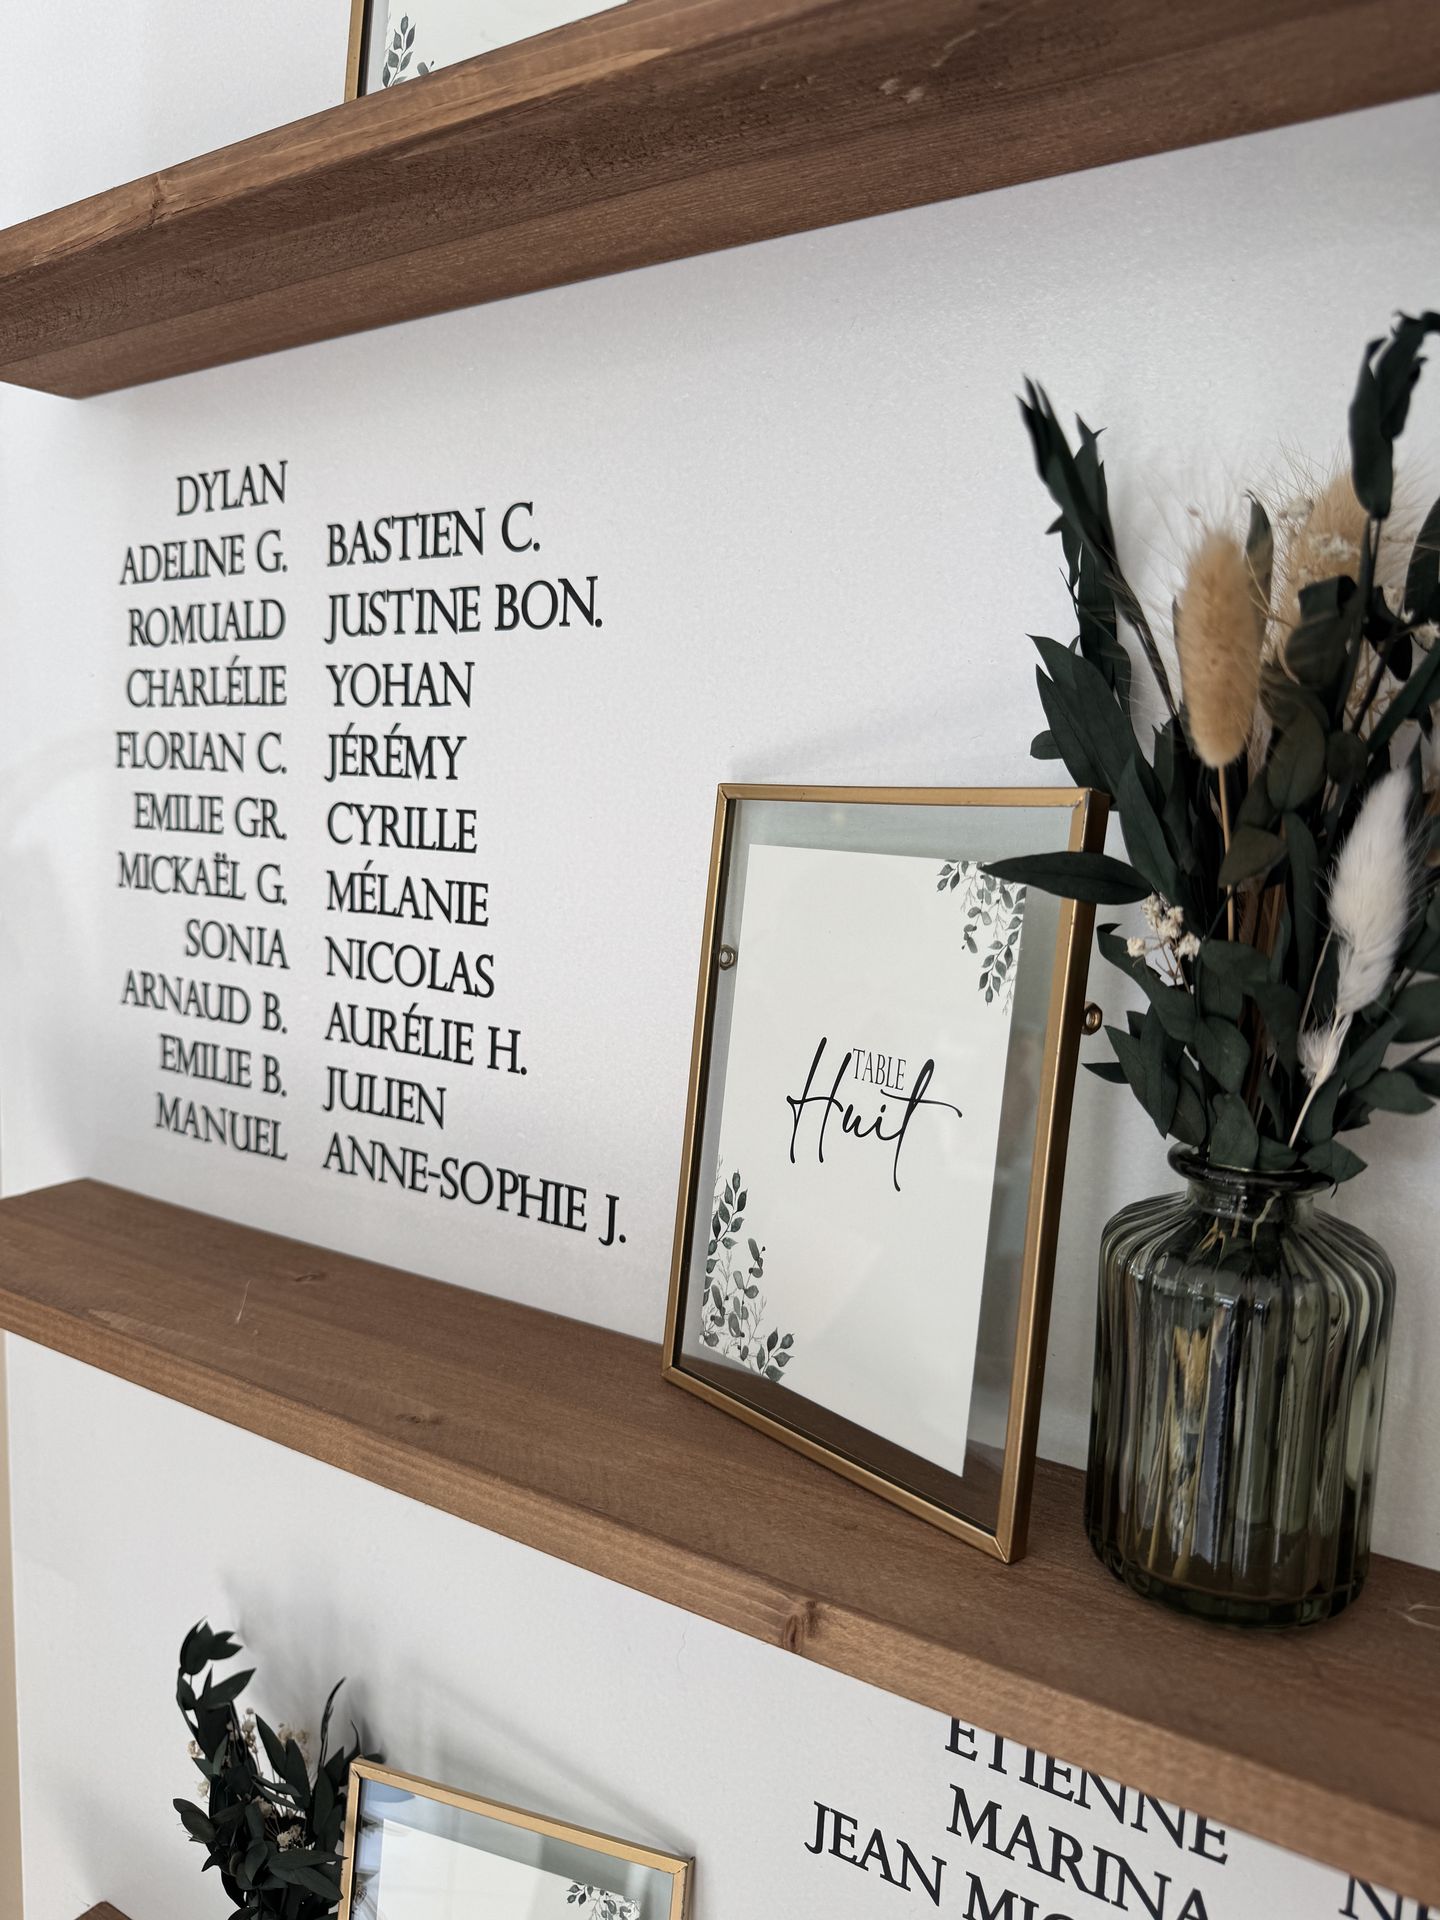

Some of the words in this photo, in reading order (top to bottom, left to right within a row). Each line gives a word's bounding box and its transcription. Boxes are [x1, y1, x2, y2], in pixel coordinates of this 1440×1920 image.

[176, 460, 288, 516] DYLAN
[120, 533, 245, 585] ADELINE
[256, 529, 288, 573] G.
[326, 507, 486, 567] BASTIEN
[501, 501, 541, 553] C.
[127, 599, 286, 647] ROMUALD
[324, 585, 481, 644] JUSTINE
[494, 575, 603, 631] BON.
[126, 655, 287, 708] CHARLÉLIE
[325, 661, 475, 708] YOHAN
[115, 731, 245, 773] FLORIAN
[256, 731, 287, 774] C.
[324, 722, 467, 783] JÉRÉMY
[133, 792, 224, 835] EMILIE
[234, 797, 288, 841] GR.
[327, 801, 478, 854] CYRILLE
[117, 851, 246, 901] MICKAËL
[256, 863, 287, 905] G.
[325, 859, 489, 927] MÉLANIE
[185, 919, 290, 969] SONIA
[324, 936, 496, 999] NICOLAS
[121, 969, 251, 1026] ARNAUD
[261, 991, 288, 1034] B.
[159, 1034, 252, 1088] EMILIE
[261, 1054, 287, 1097] B.
[324, 1001, 475, 1067] AURÉLIE
[486, 1025, 528, 1076] H.
[852, 1047, 907, 1091] TABLE
[155, 1092, 288, 1161] MANUEL
[322, 1066, 447, 1131] JULIEN
[786, 1036, 963, 1192] Huit
[322, 1132, 587, 1233] ANNE-SOPHIE
[598, 1193, 627, 1247] J.
[804, 1800, 948, 1907] JEAN
